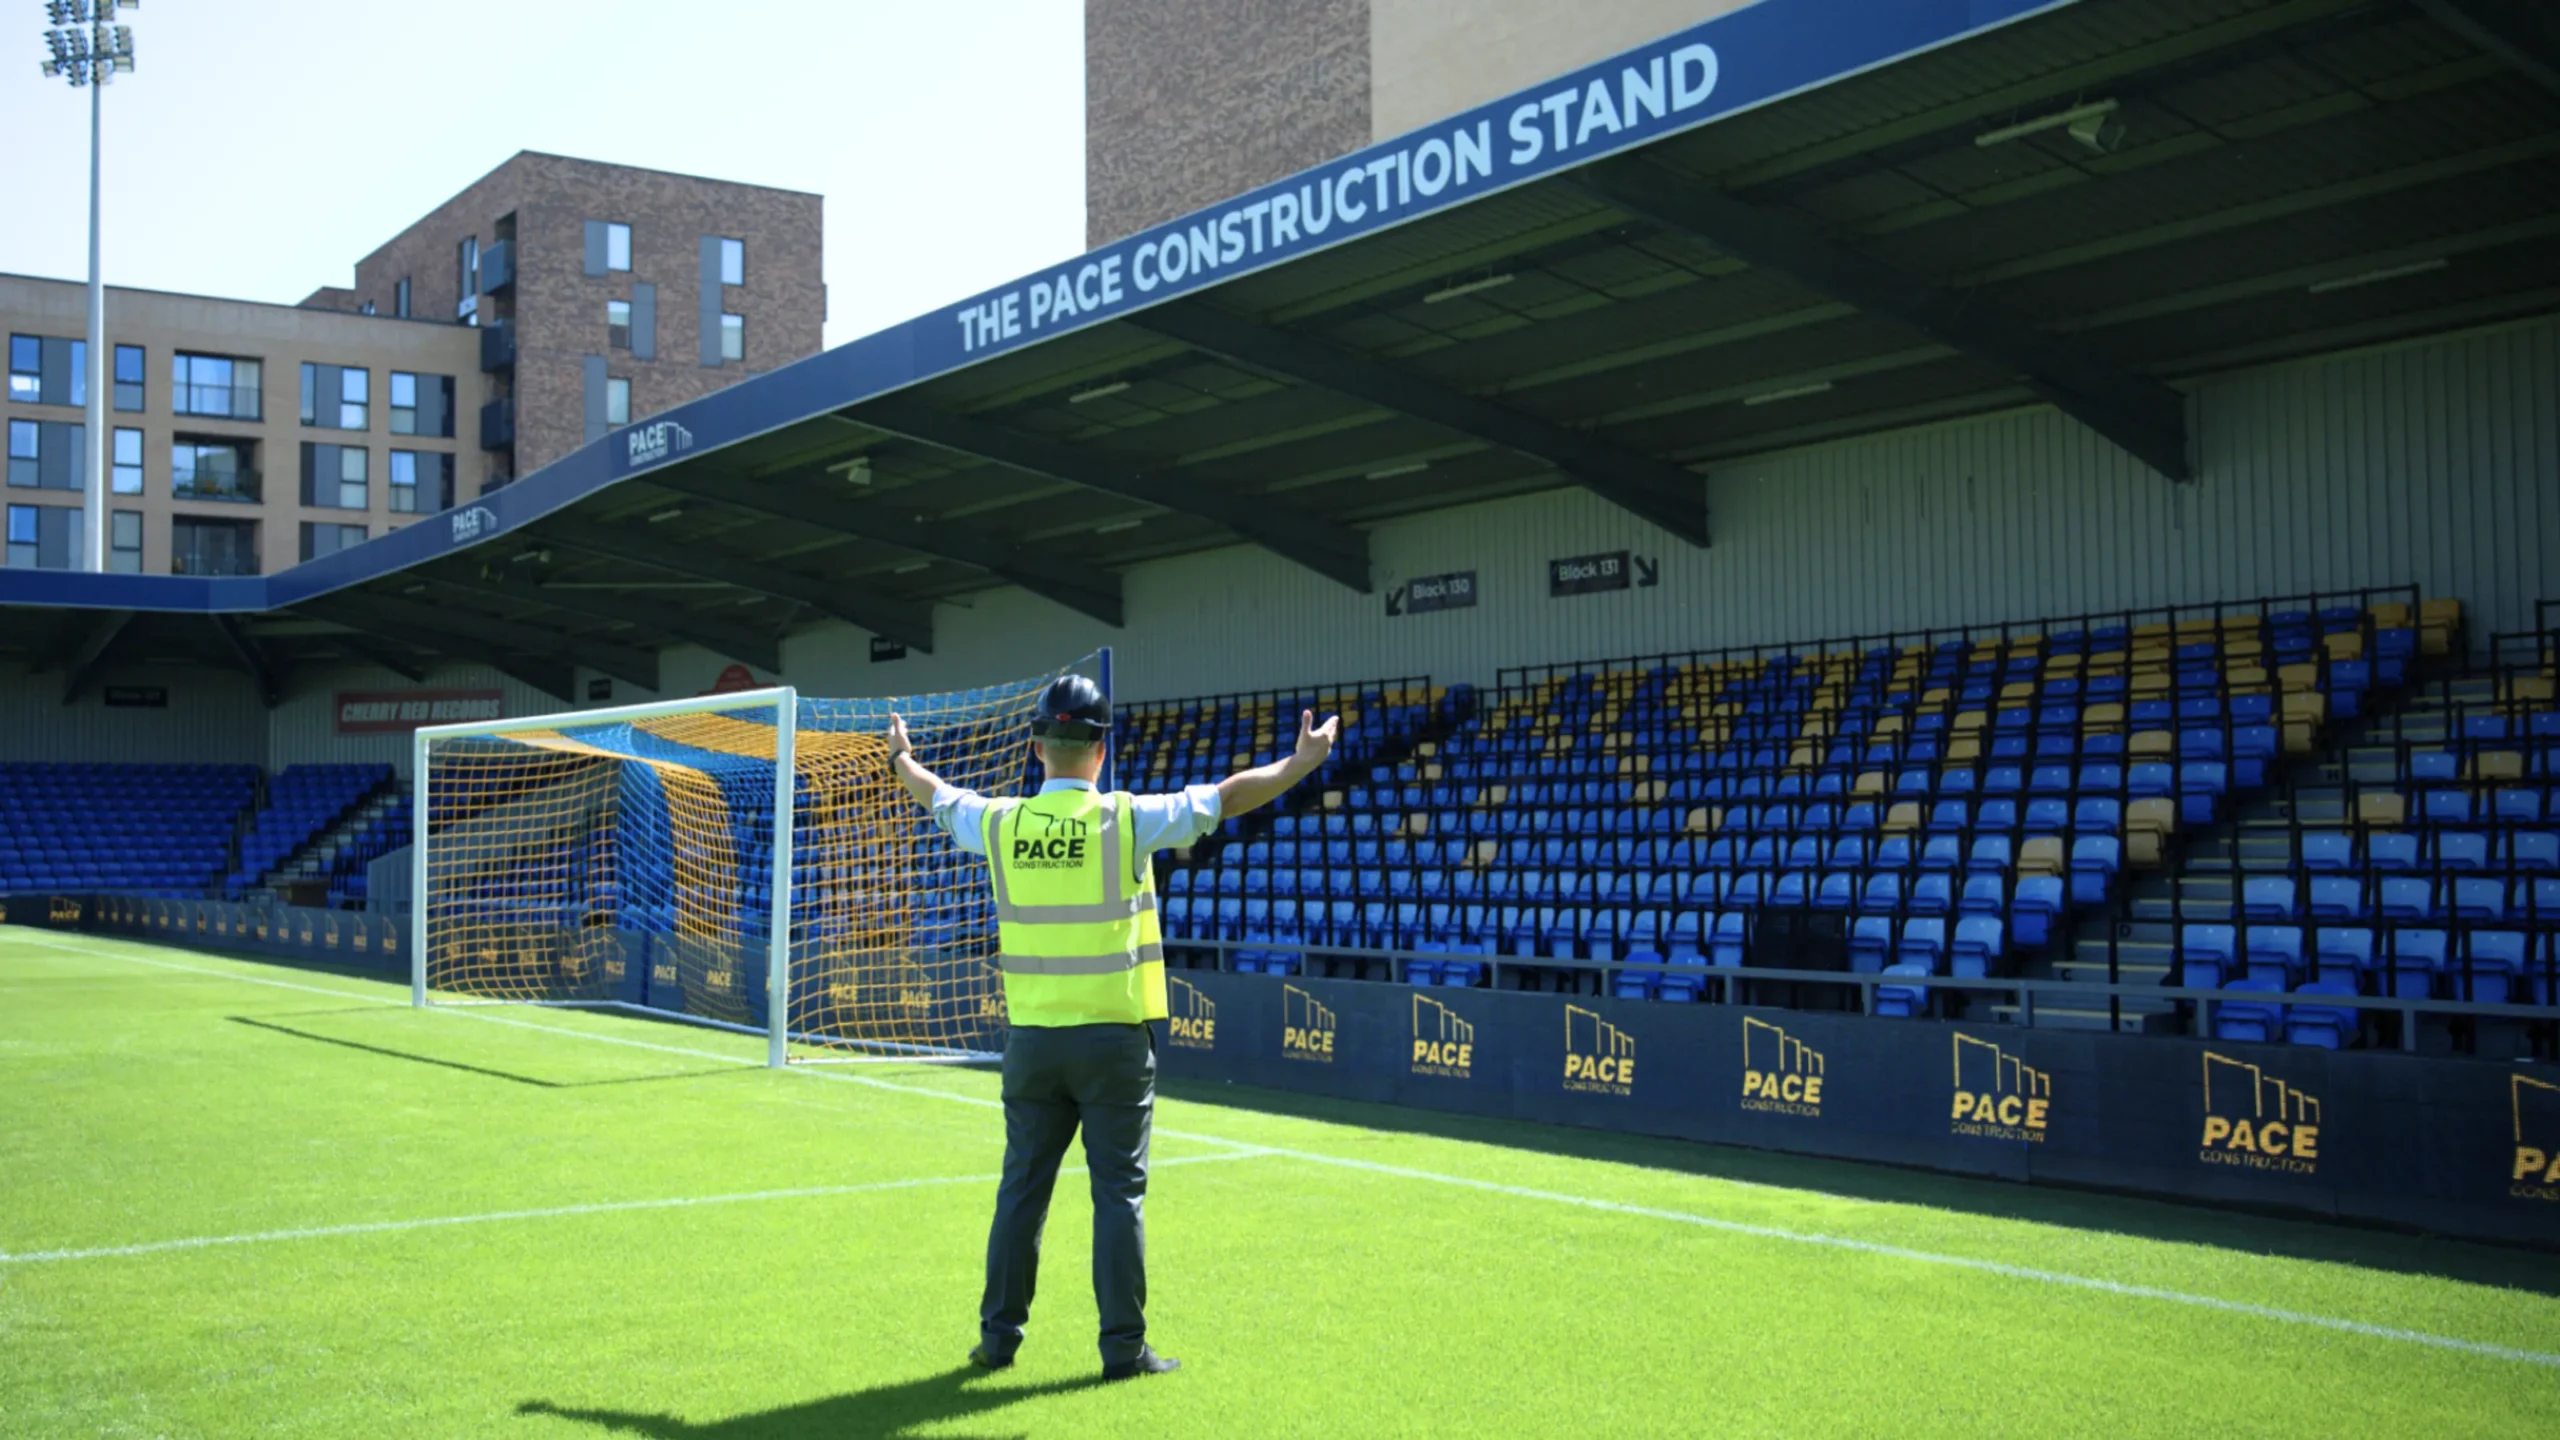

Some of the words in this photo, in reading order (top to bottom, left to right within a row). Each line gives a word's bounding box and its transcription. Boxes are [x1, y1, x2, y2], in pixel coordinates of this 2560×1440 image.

[958, 291, 1021, 352] THE
[1030, 253, 1123, 329] PACE
[1132, 119, 1492, 292] CONSTRUCTION
[1508, 42, 1719, 165] STAND
[629, 422, 665, 456] PACE
[453, 507, 478, 533] PACE
[1559, 561, 1597, 581] Block
[1601, 559, 1619, 577] 131
[1413, 579, 1447, 599] Block
[1448, 579, 1470, 595] 130
[341, 702, 400, 722] CHERRY
[400, 701, 430, 720] RED
[431, 699, 500, 720] RECORDS
[1013, 838, 1086, 859] PACE
[1013, 859, 1083, 869] CONSTRUCTION
[653, 964, 676, 982] PACE
[706, 969, 732, 987] PACE
[980, 998, 1008, 1018] PAC
[1169, 1016, 1215, 1040] PACE
[1283, 1026, 1335, 1053] PACE
[1413, 1039, 1472, 1068] PACE
[1564, 1053, 1635, 1085] PACE
[1743, 1070, 1823, 1104] PACE
[1741, 1098, 1820, 1117] CONSTRUCTION
[1951, 1091, 2049, 1129] PACE
[2202, 1115, 2319, 1158] PACE
